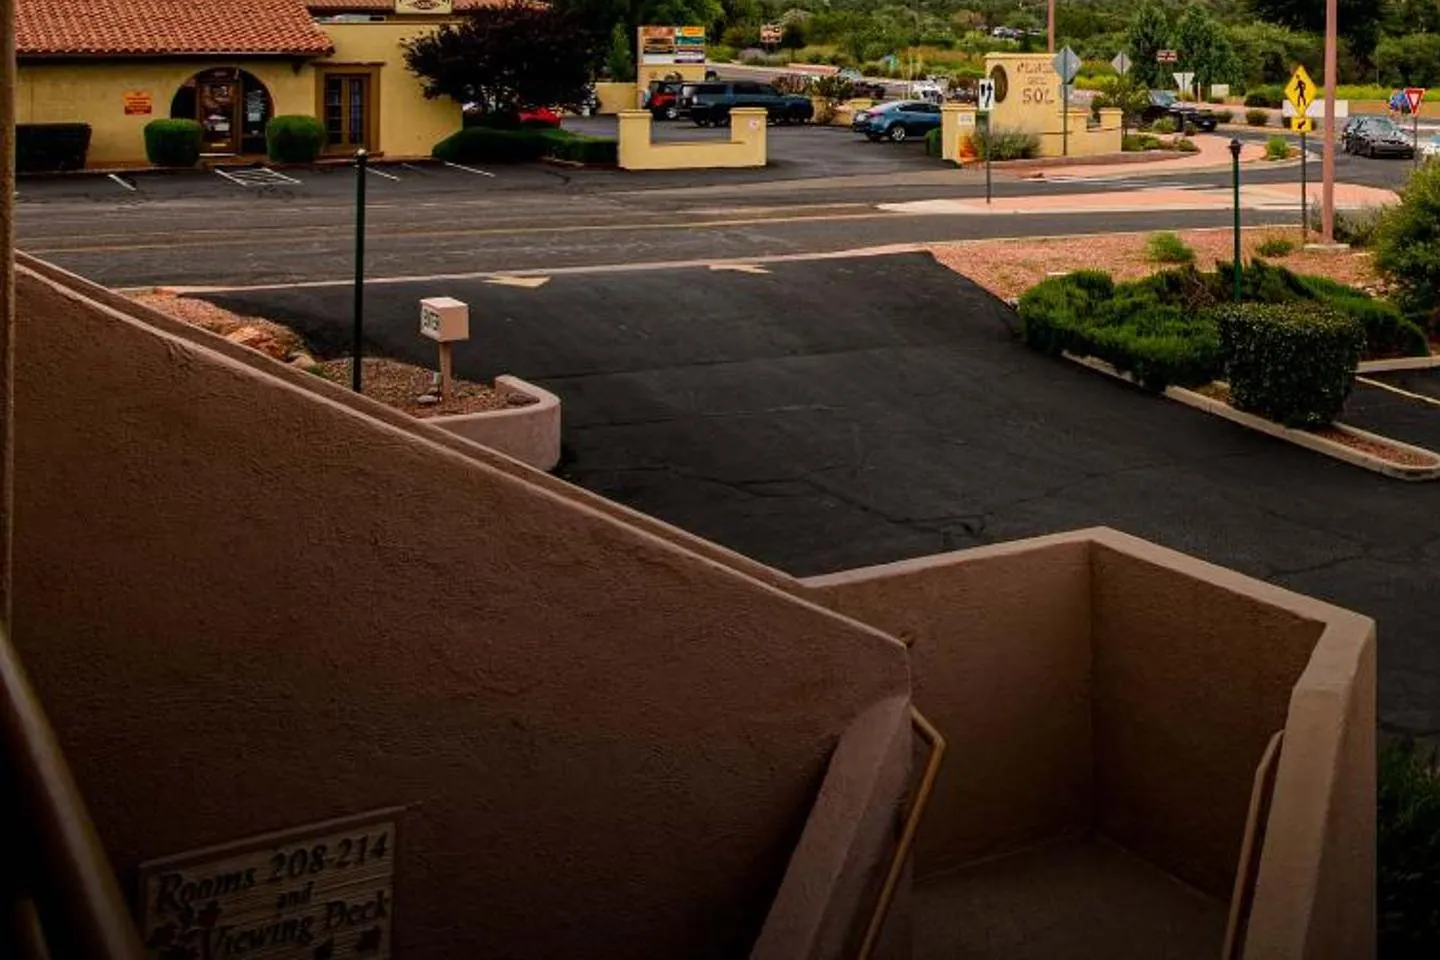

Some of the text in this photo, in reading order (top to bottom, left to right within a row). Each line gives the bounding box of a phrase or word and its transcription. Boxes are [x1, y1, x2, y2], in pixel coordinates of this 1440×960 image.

[1022, 87, 1055, 105] SOL
[157, 832, 388, 914] Rooms 208-214
[277, 881, 315, 909] and
[325, 890, 390, 930] Deck
